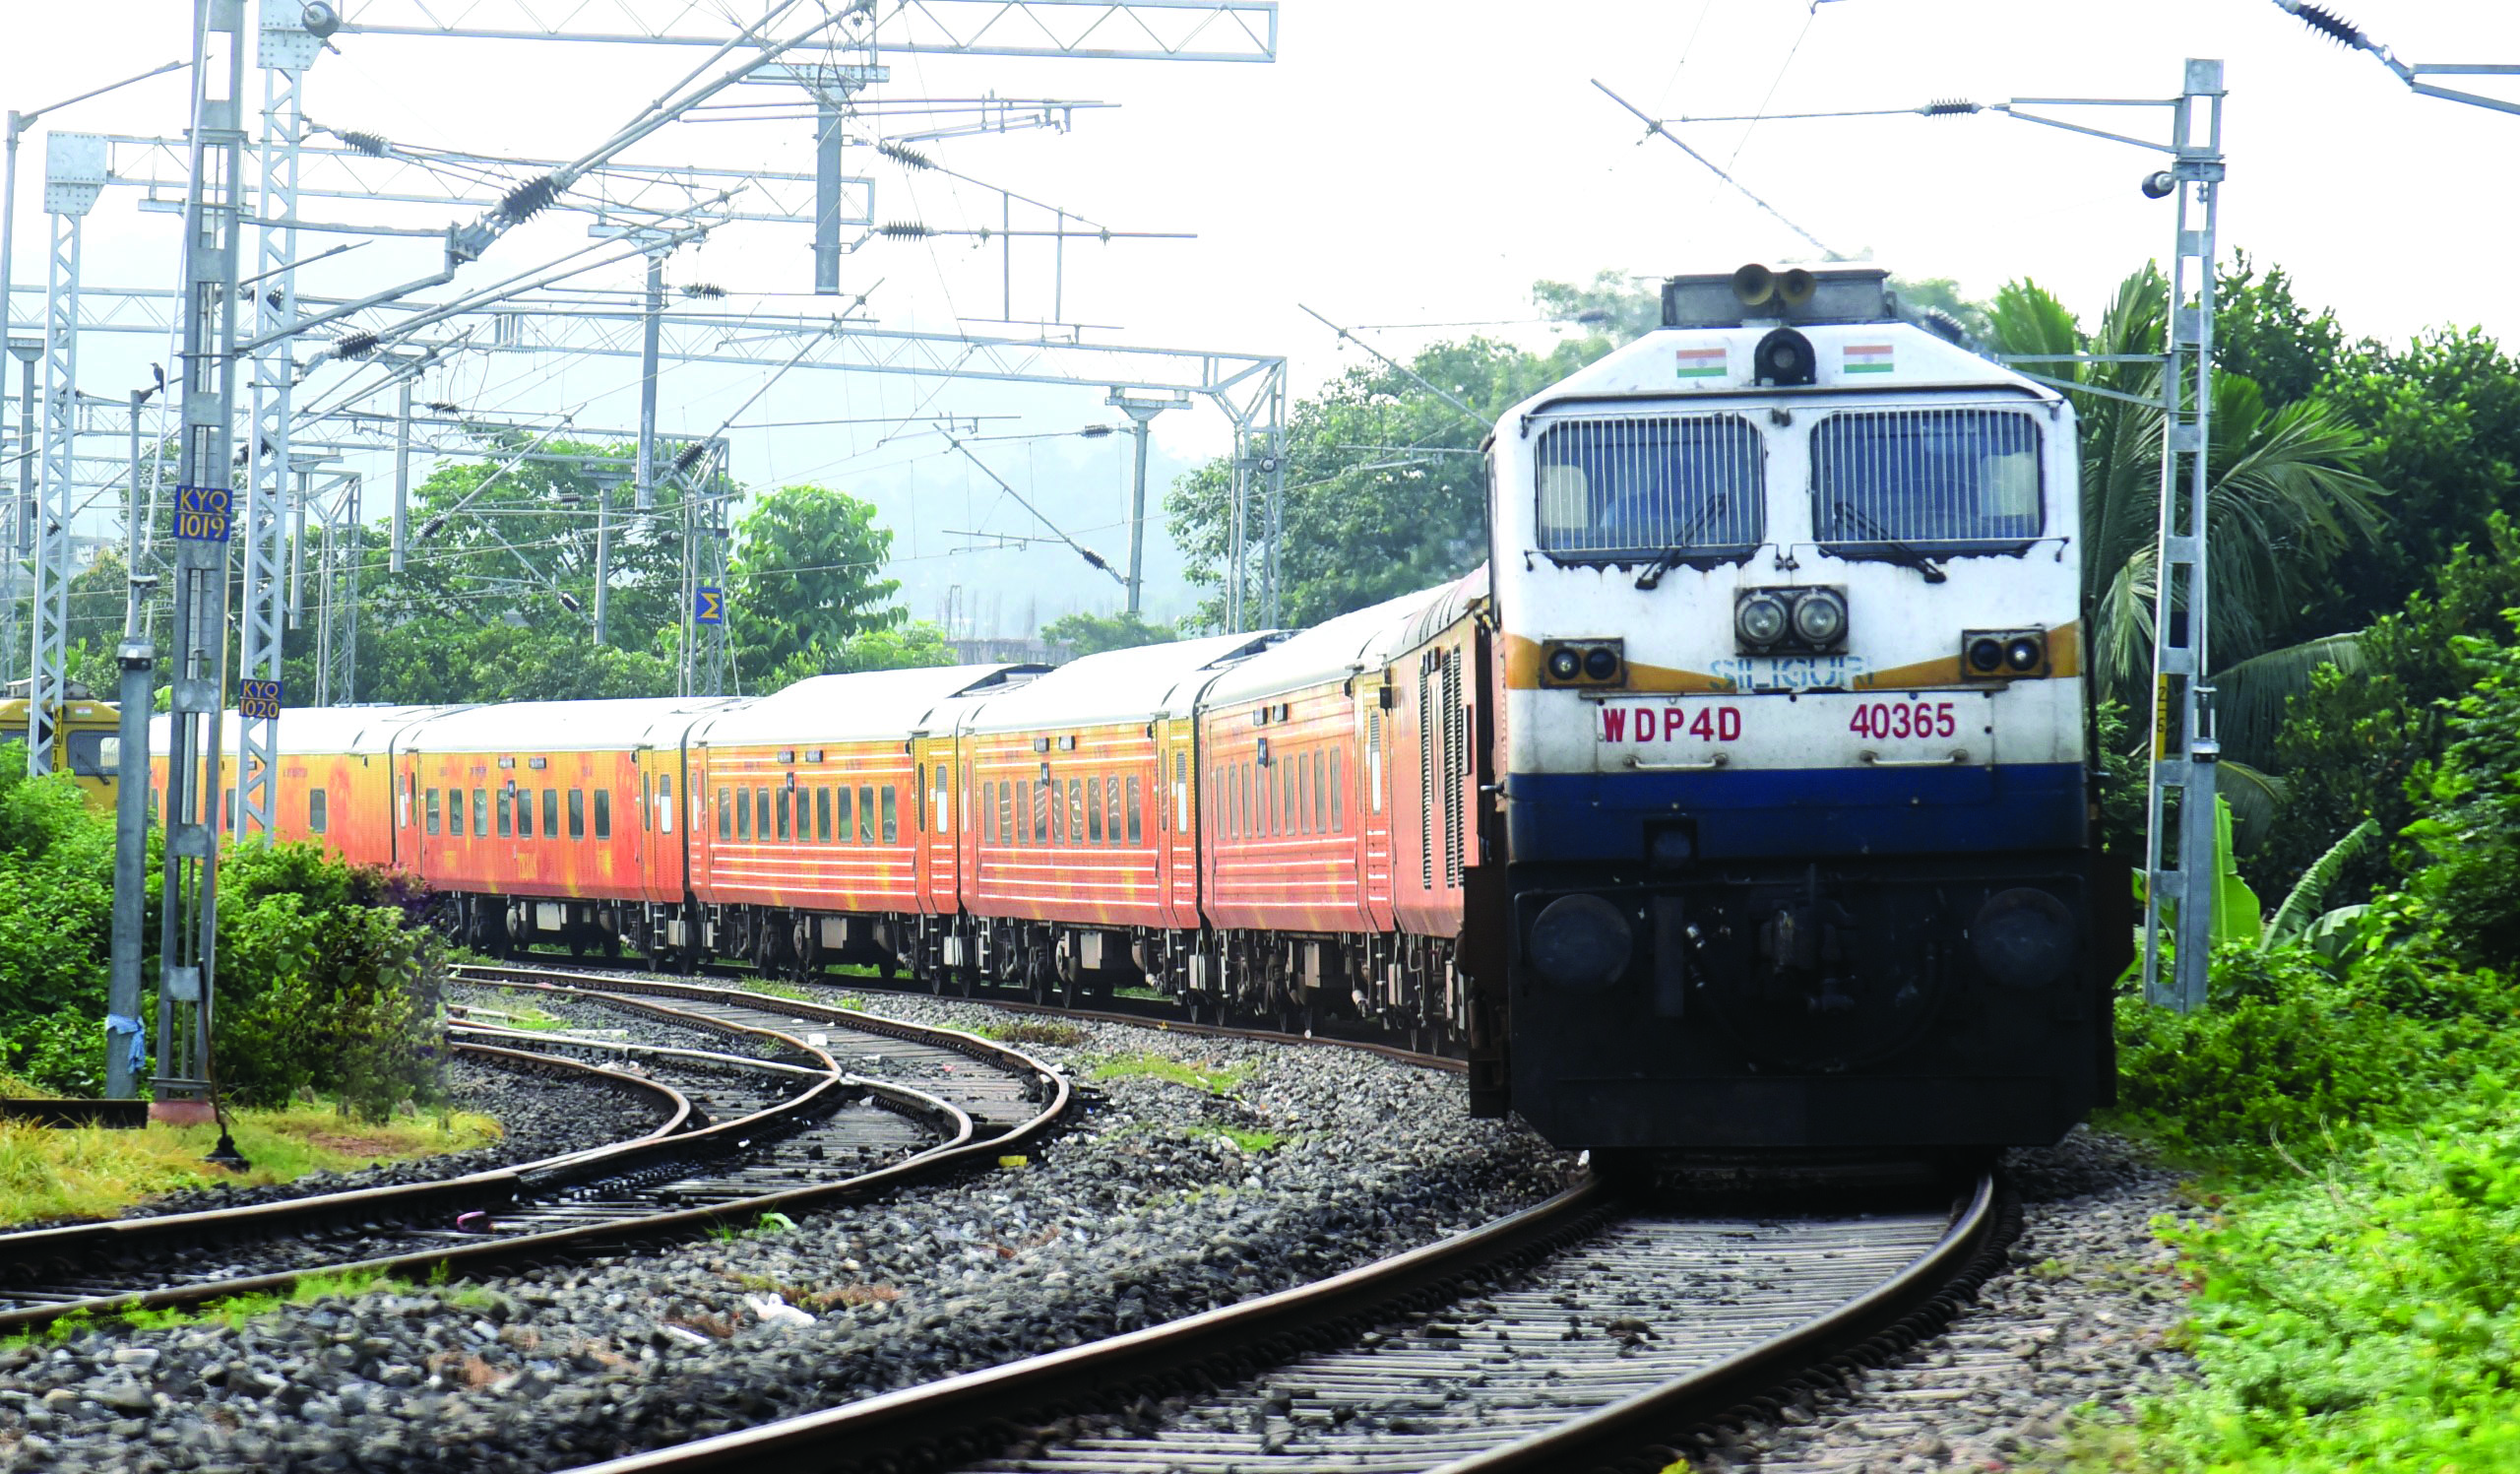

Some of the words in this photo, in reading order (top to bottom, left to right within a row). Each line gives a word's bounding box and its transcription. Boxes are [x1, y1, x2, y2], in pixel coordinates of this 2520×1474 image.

[179, 487, 228, 513] KYQ
[179, 514, 225, 539] 1019
[243, 680, 279, 700] KYQ
[240, 699, 280, 718] 1020
[1602, 706, 1741, 742] WDP4D
[1849, 702, 1955, 738] 40365
